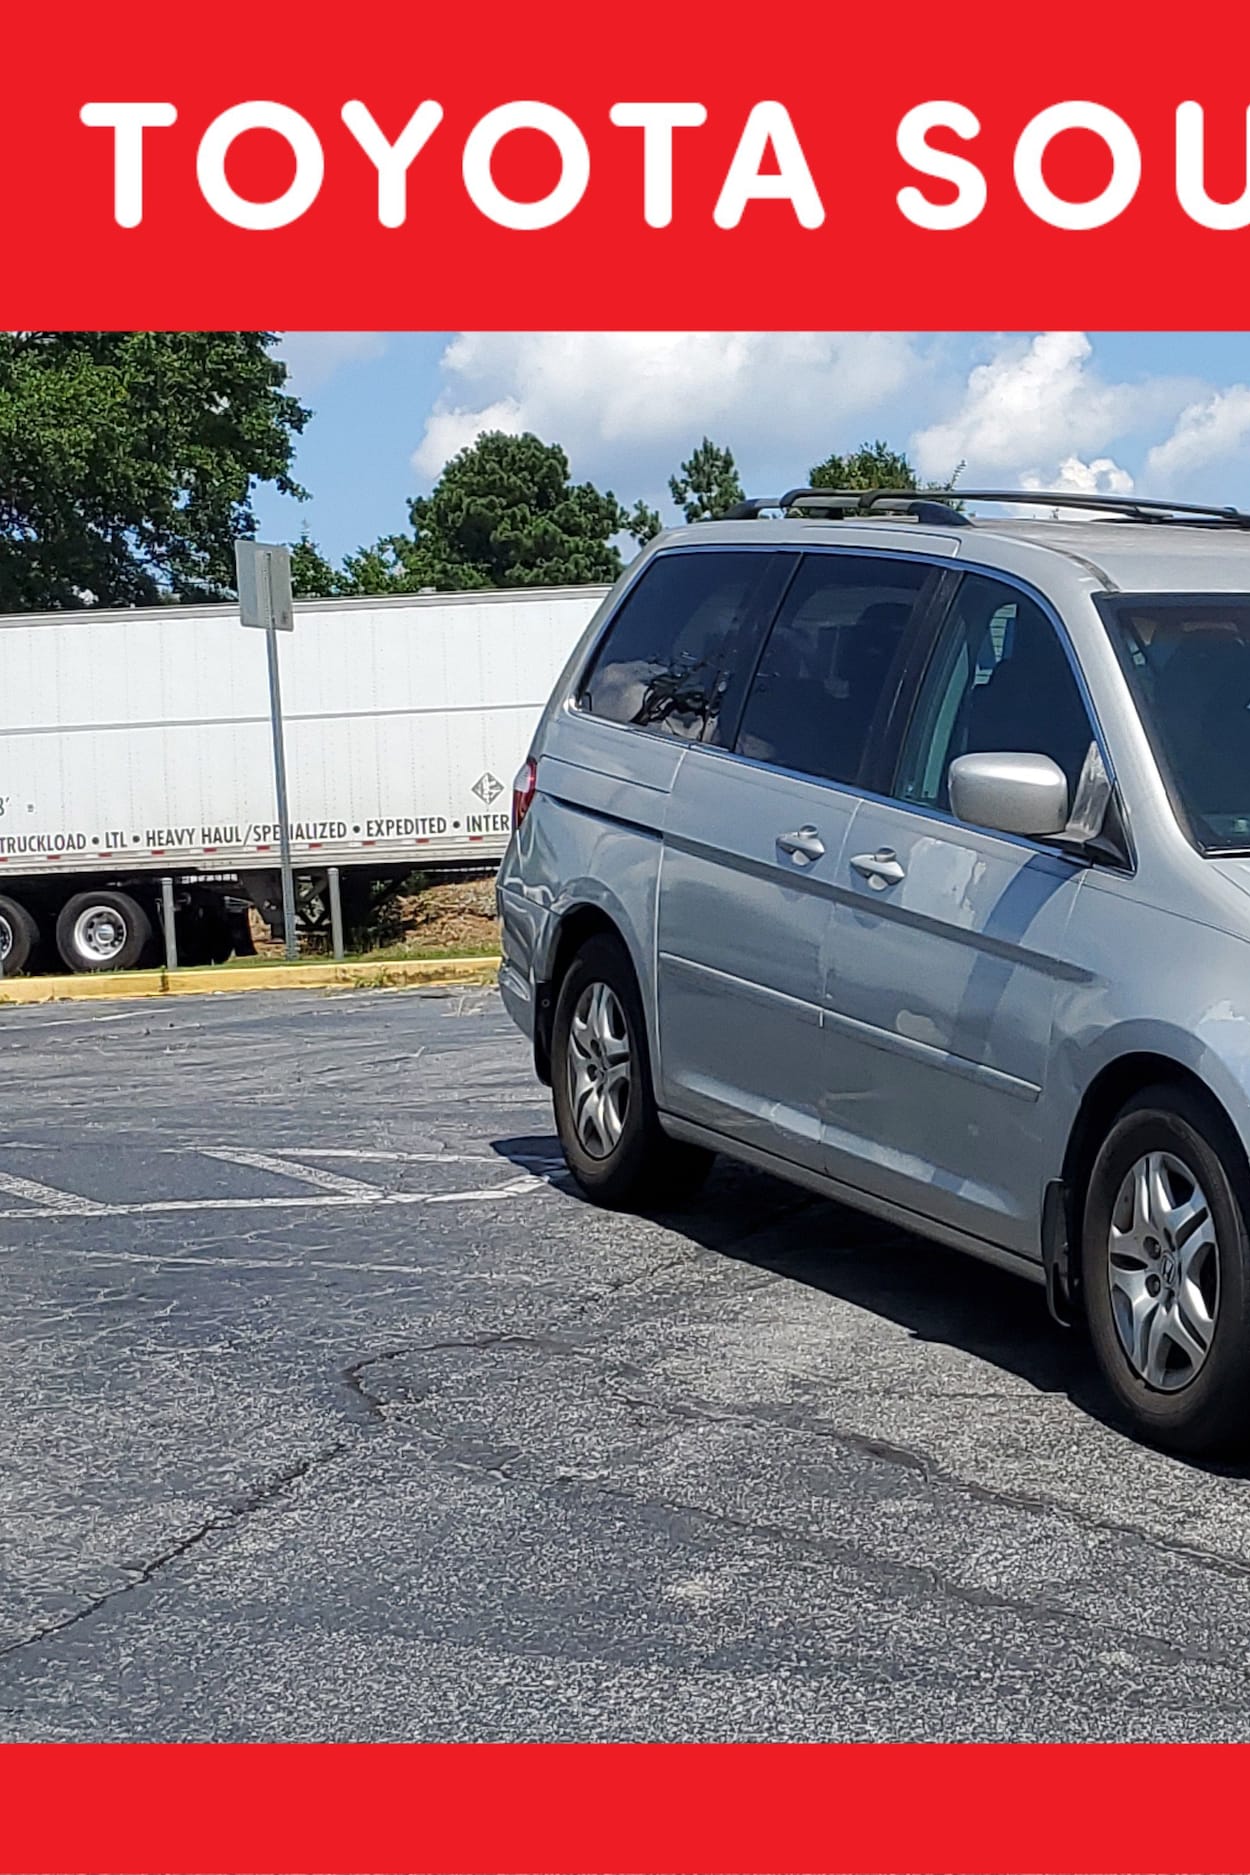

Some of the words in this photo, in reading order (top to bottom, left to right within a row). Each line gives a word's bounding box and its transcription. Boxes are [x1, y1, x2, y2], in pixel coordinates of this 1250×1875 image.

[0, 833, 87, 854] TRUCKLOAD
[105, 831, 127, 849] LTL
[146, 828, 196, 847] HEAVY
[201, 822, 347, 847] HAUL/SPEIALIZED
[366, 817, 447, 837] EXPEDITED
